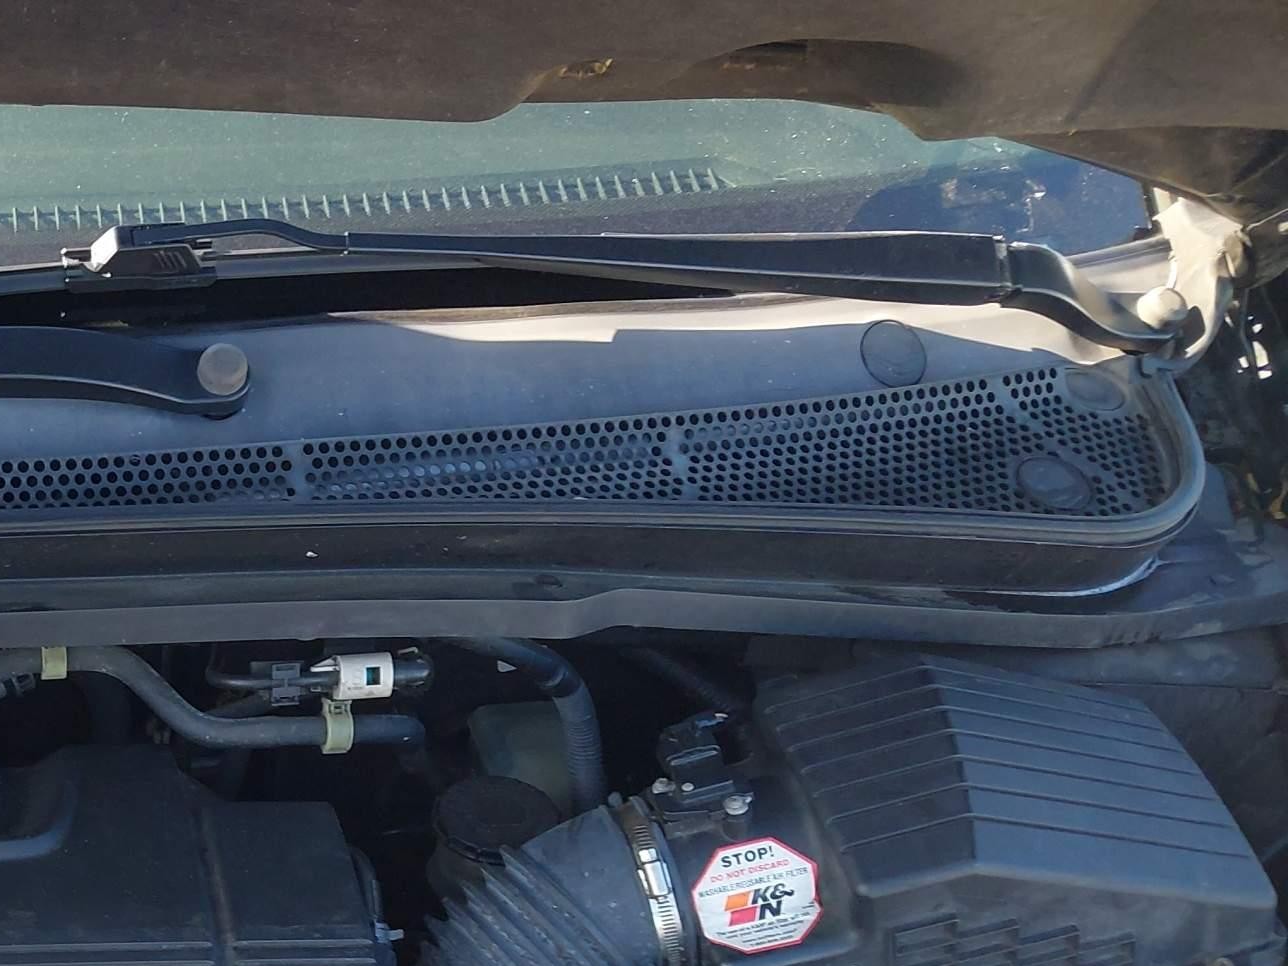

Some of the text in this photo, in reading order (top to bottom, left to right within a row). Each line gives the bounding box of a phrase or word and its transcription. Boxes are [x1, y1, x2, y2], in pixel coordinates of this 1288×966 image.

[721, 846, 774, 868] STOP!
[710, 860, 790, 883] DO NOT DISCARD
